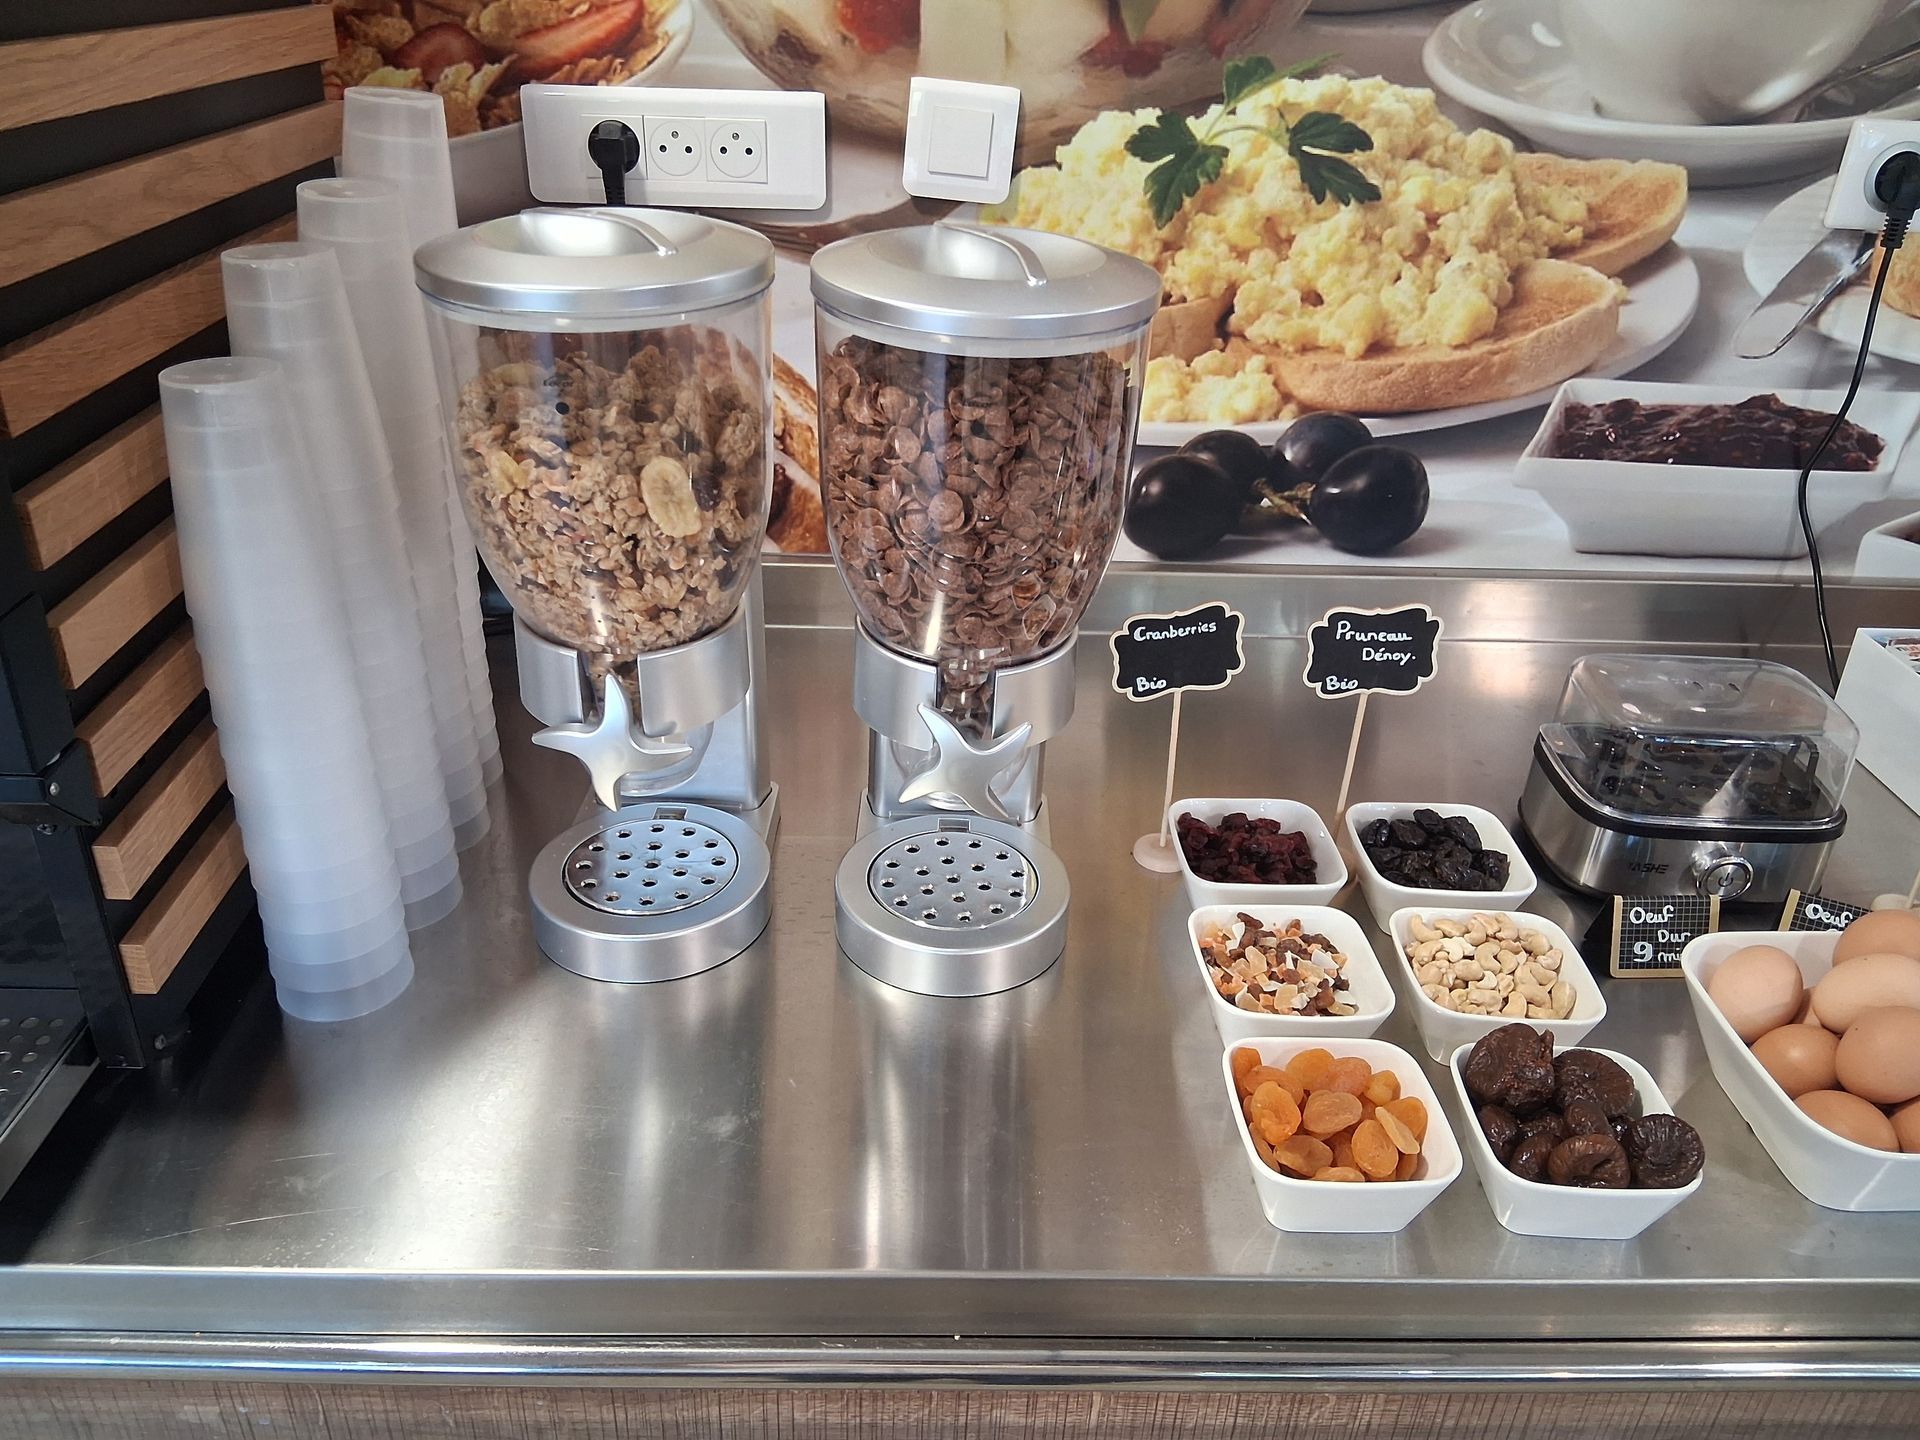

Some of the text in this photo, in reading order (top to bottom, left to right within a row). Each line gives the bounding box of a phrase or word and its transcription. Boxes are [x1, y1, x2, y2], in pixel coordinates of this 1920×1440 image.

[1133, 621, 1217, 642] Cranberries
[1336, 620, 1413, 641] Pruneau
[1136, 677, 1167, 692] Bio
[1325, 675, 1358, 690] Bio
[1629, 904, 1675, 924] Oeuf
[1805, 903, 1853, 928] Oeuf
[1657, 929, 1691, 943] Dur
[1633, 941, 1653, 962] 9
